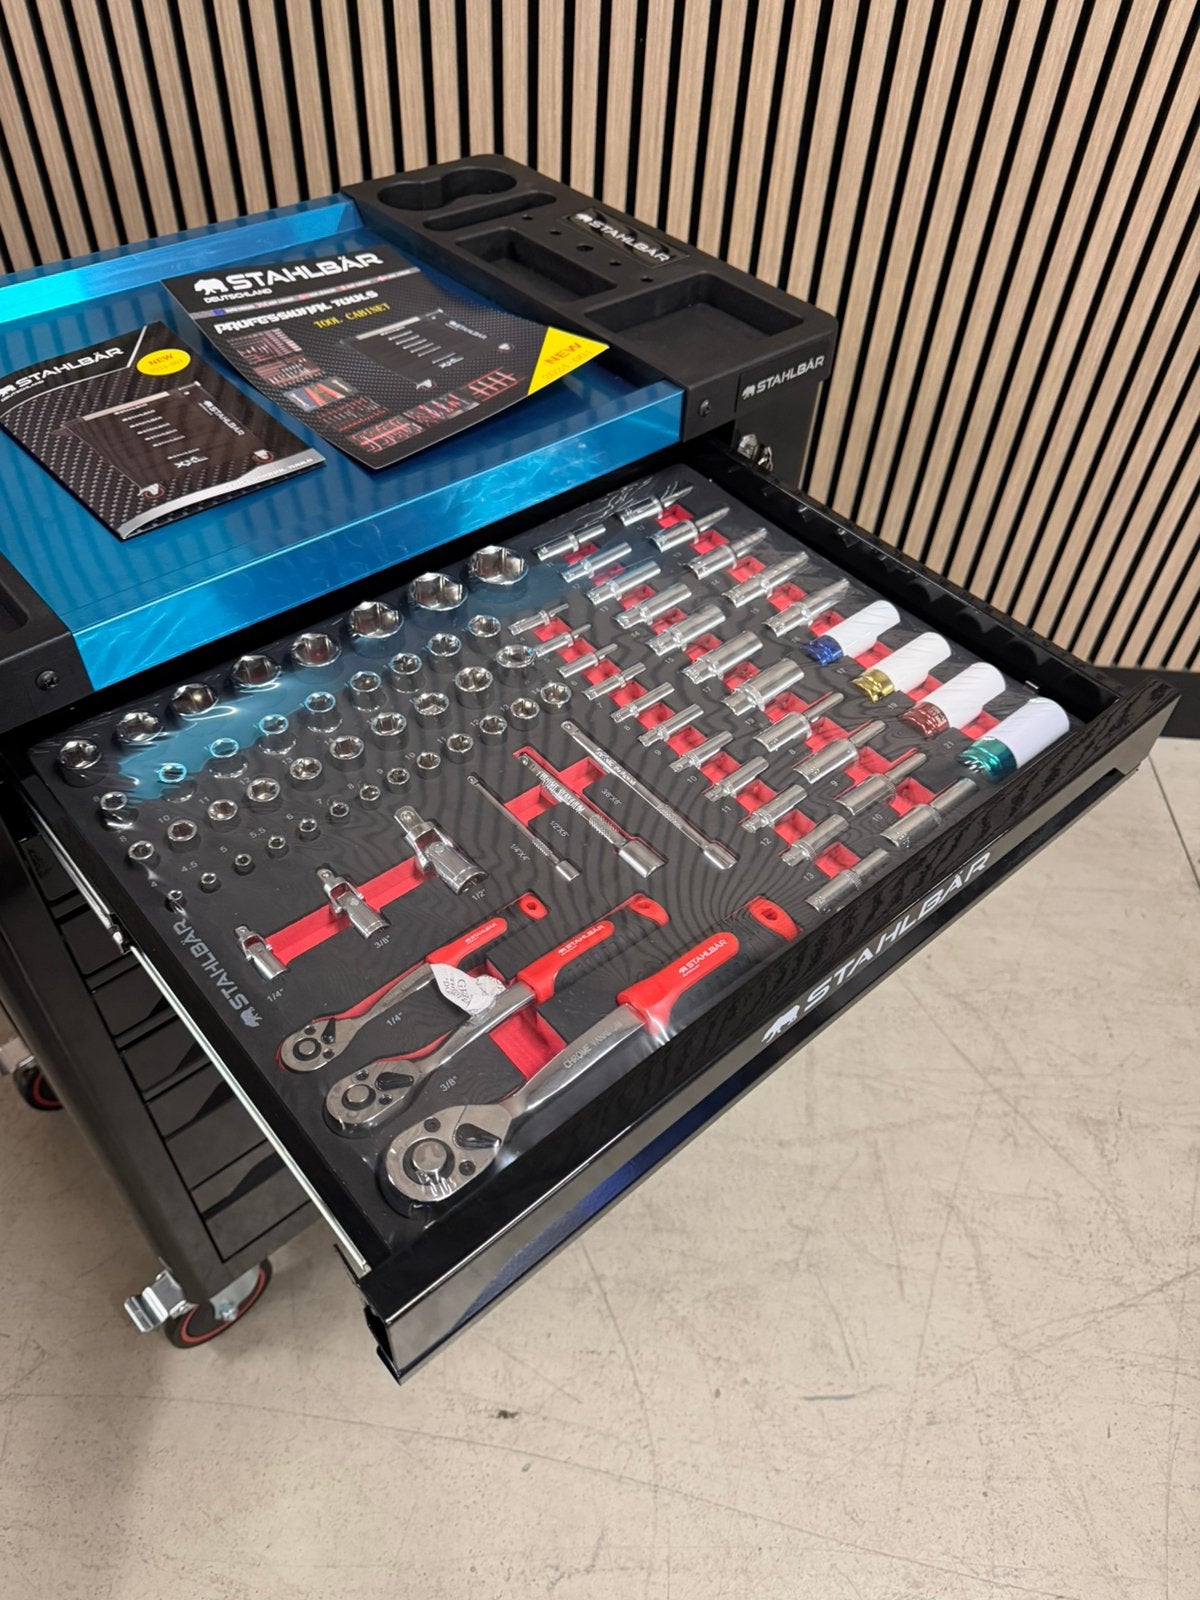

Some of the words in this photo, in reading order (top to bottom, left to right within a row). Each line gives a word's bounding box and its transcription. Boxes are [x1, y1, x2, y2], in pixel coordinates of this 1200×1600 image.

[589, 219, 671, 262] STAHLBÄR
[226, 253, 384, 290] STAHLBÄR
[203, 288, 273, 304] DEUTSCHLAND
[214, 303, 332, 334] PROFESSIONAL
[332, 290, 378, 308] TOOLS
[313, 318, 343, 329] TOOL
[345, 302, 390, 320] CABINET
[149, 353, 174, 366] NEW
[545, 341, 582, 365] NEW
[15, 347, 125, 386] STAHLBÄR
[756, 355, 825, 394] STAHLBÄR
[437, 736, 447, 745] 11
[405, 752, 416, 761] 10
[239, 777, 250, 786] 12
[687, 775, 698, 785] 10
[199, 796, 210, 805] 11
[721, 804, 732, 814] 11
[158, 814, 171, 824] 10
[249, 827, 267, 839] 5.5
[219, 845, 228, 854] 5
[760, 837, 772, 847] 12
[180, 860, 198, 873] 4.5
[803, 872, 815, 881] 13
[472, 888, 487, 902] 1/2"
[804, 851, 991, 1012] STAHLBÄR
[374, 935, 391, 950] 3/8"
[687, 939, 728, 969] STAHLBÄR
[172, 917, 250, 1010] STAHLBÄR
[267, 987, 284, 1003] 1/4"
[386, 1011, 404, 1027] 1/4"
[440, 1075, 458, 1093] 3/8"
